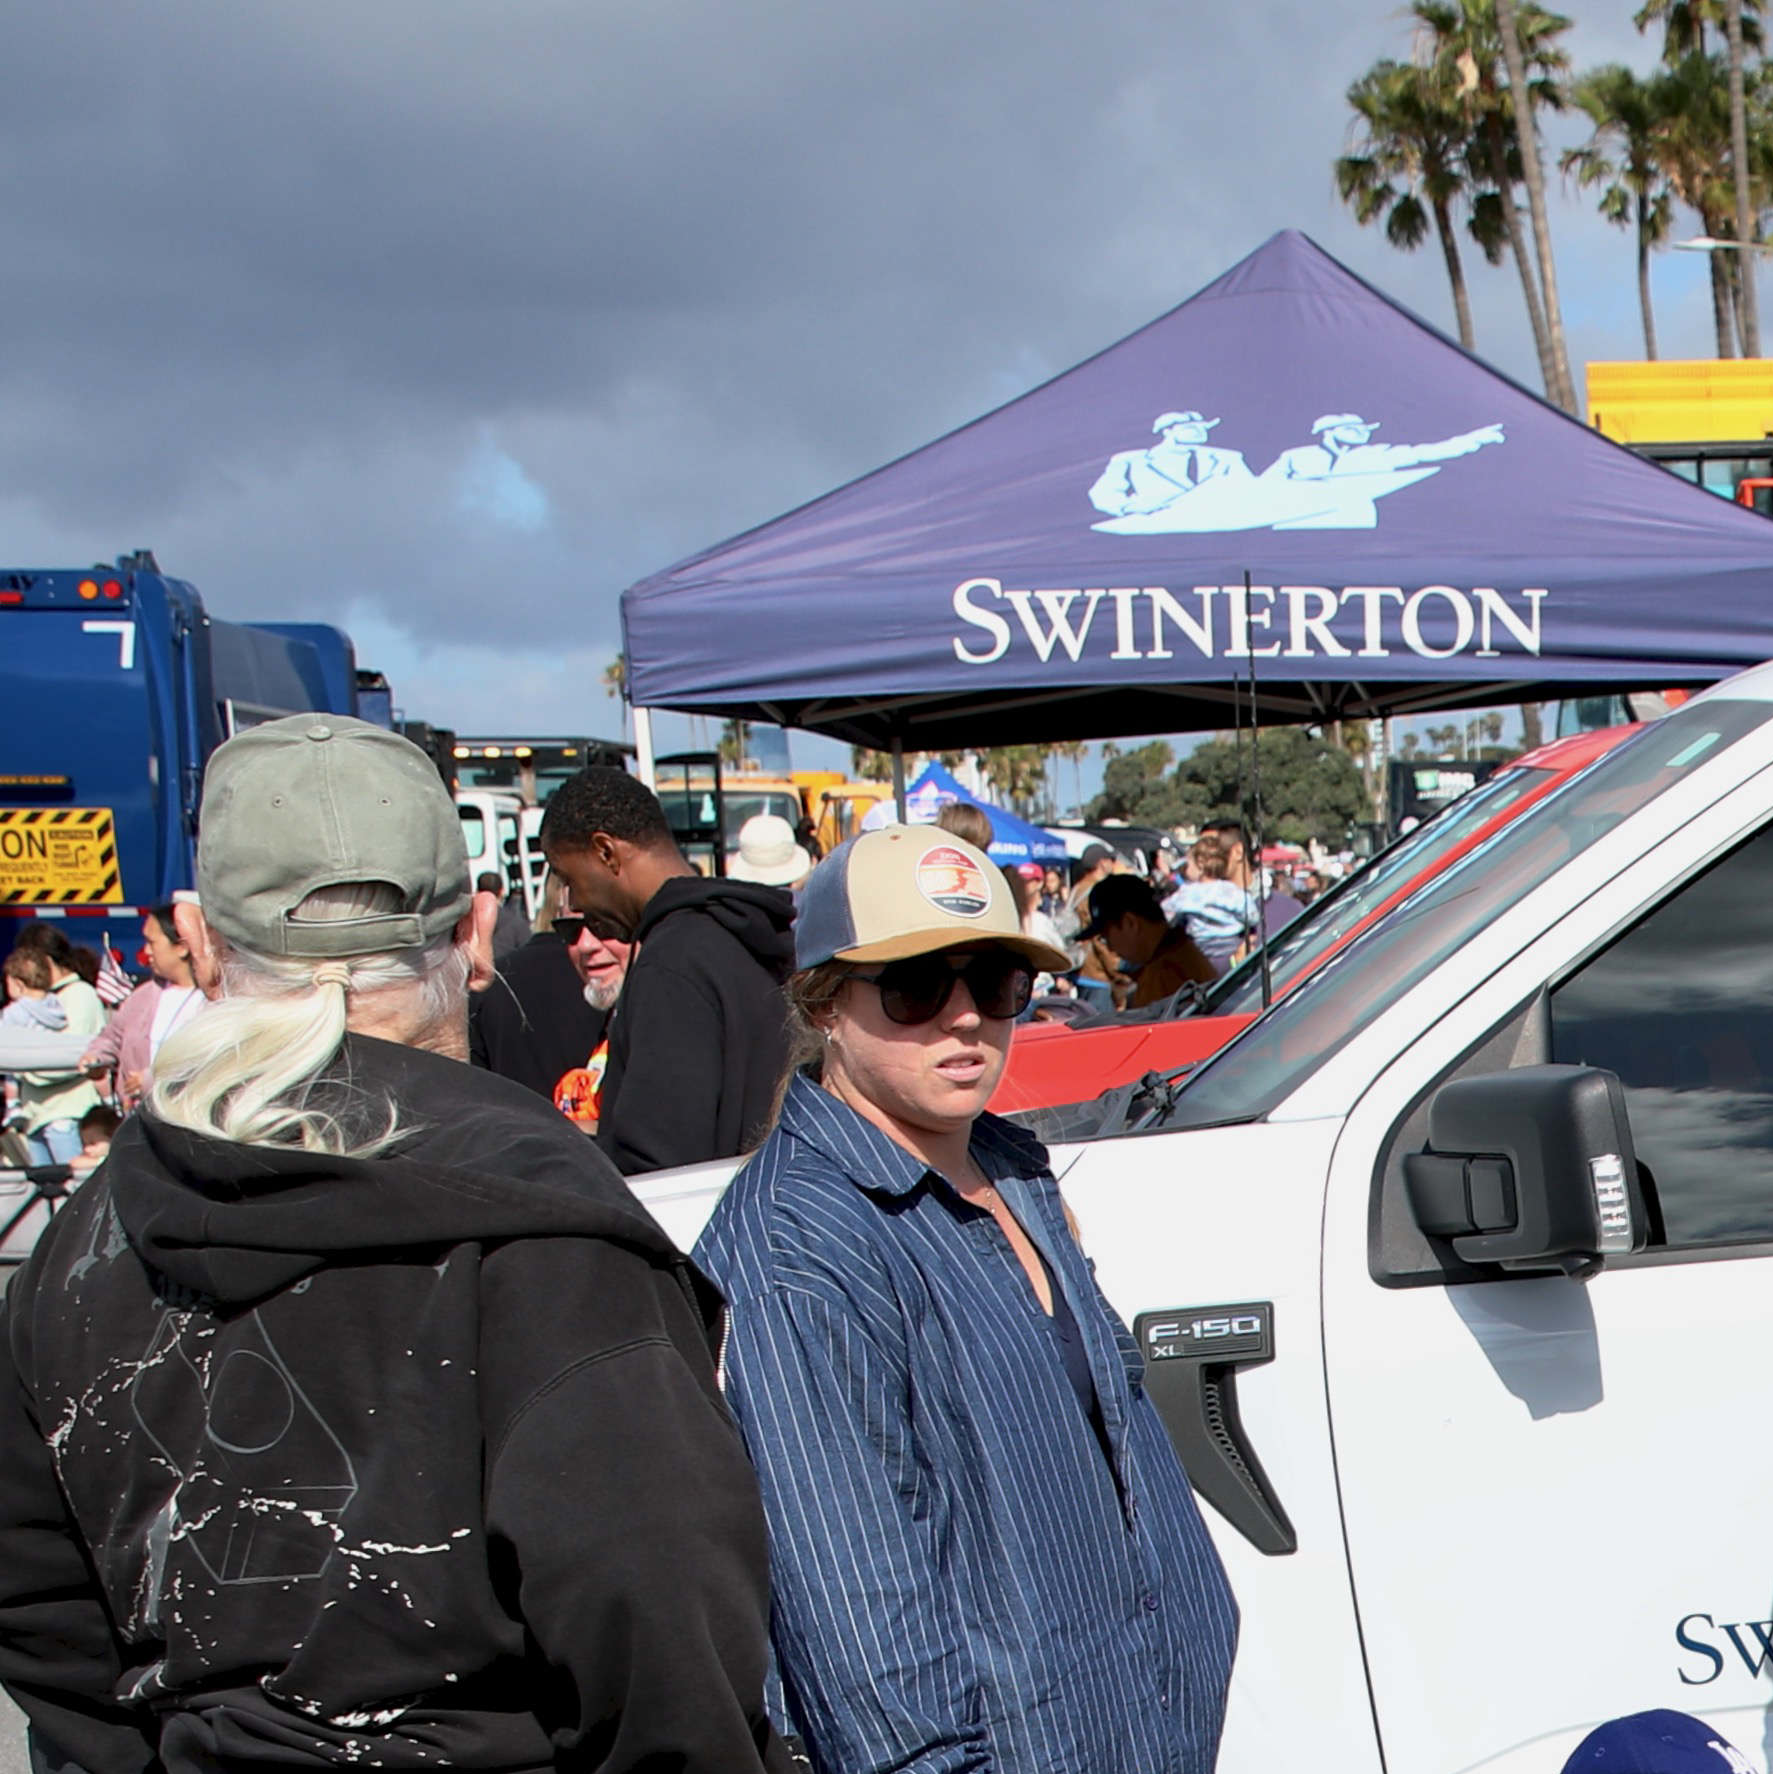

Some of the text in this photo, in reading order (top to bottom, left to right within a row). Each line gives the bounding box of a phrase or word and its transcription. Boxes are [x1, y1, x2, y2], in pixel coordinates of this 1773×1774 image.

[82, 620, 136, 669] 7
[952, 577, 1548, 664] SWINERTON
[1149, 1316, 1261, 1343] F-150
